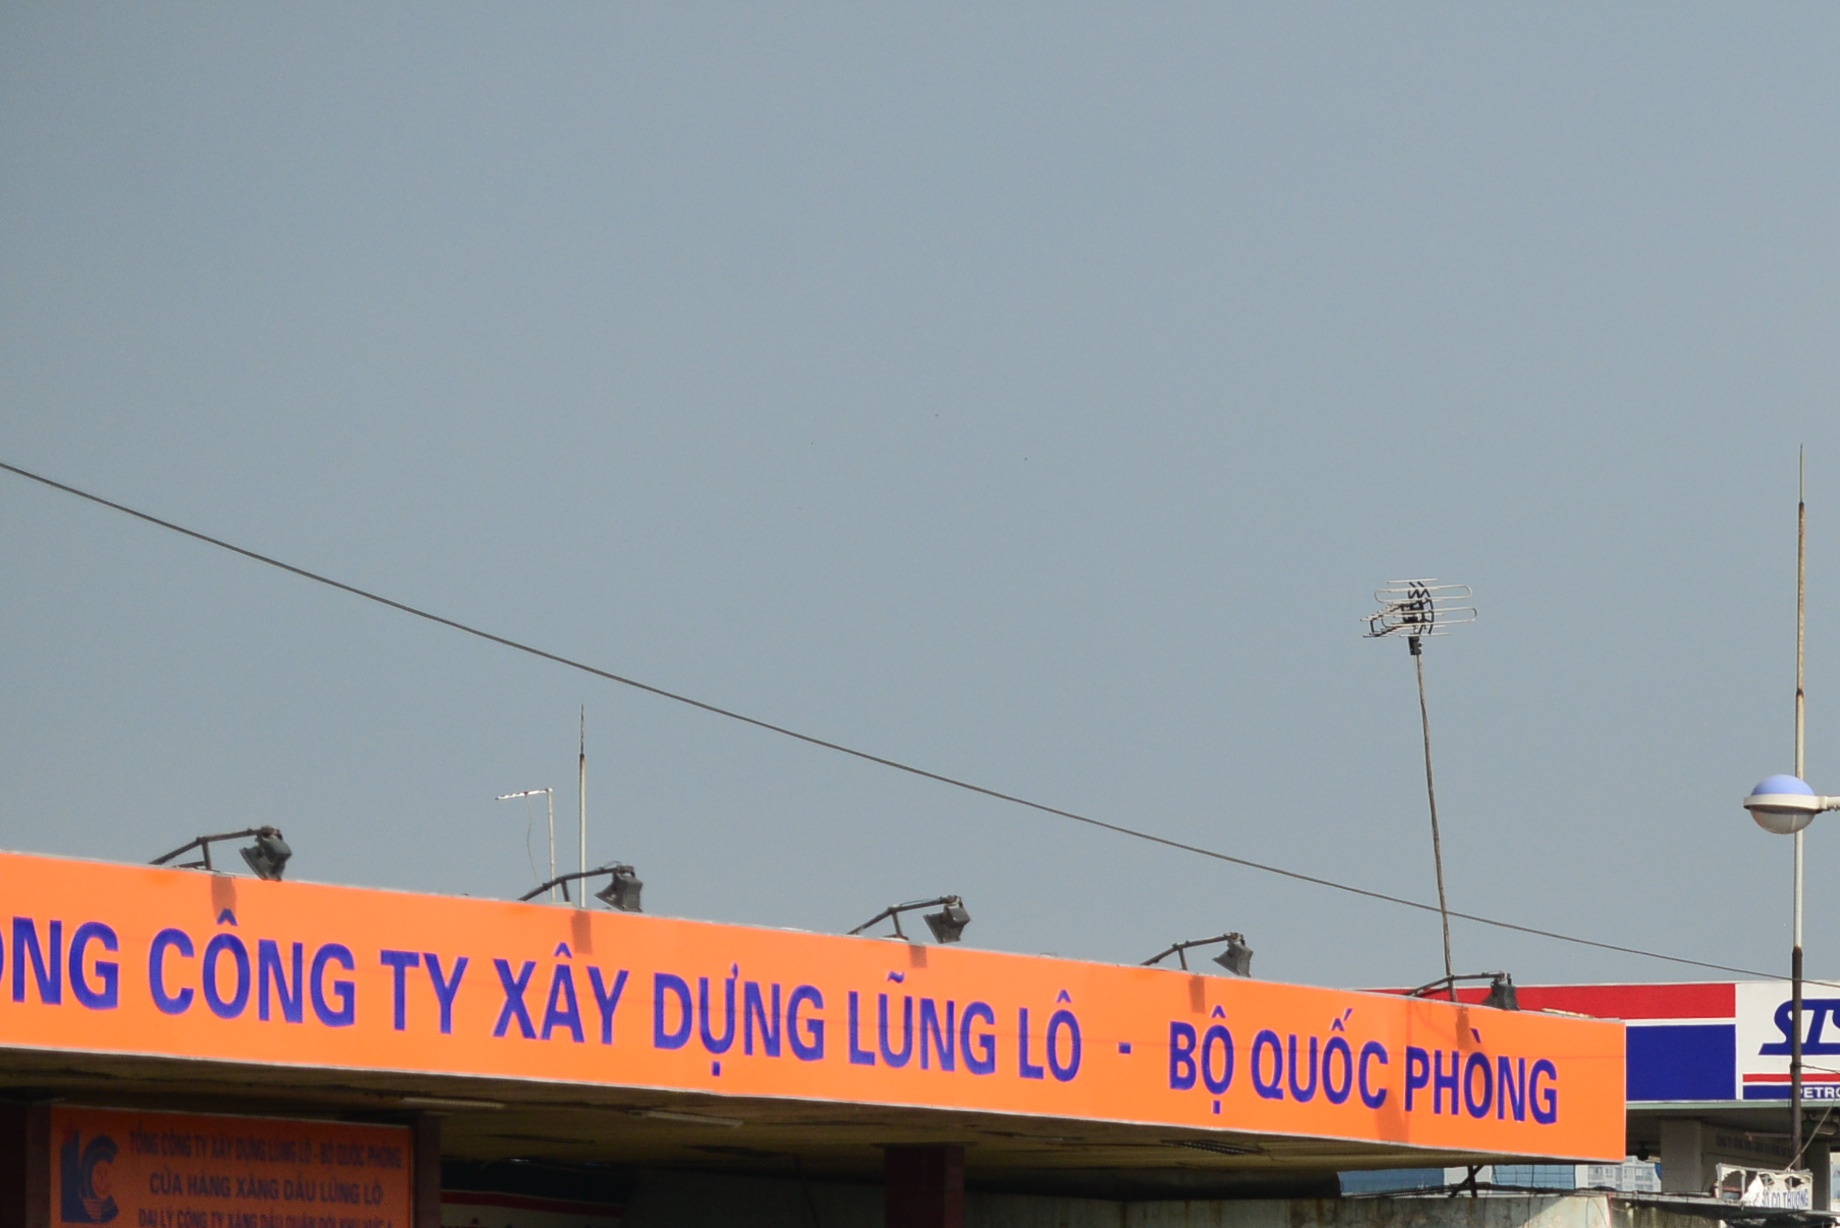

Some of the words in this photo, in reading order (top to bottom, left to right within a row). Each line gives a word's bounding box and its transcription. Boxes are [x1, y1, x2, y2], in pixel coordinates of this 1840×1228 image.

[0, 918, 119, 1010] NG
[149, 909, 355, 1027] CÔNG
[380, 950, 469, 1034] TY
[494, 943, 629, 1044] XÂY
[654, 965, 824, 1076] DỰNG
[849, 972, 996, 1075] LŨNG
[1019, 990, 1082, 1082] LÔ
[1170, 1006, 1235, 1114] BỘ
[1251, 1008, 1388, 1109] QUỐC
[1407, 1028, 1557, 1125] PHÒNG
